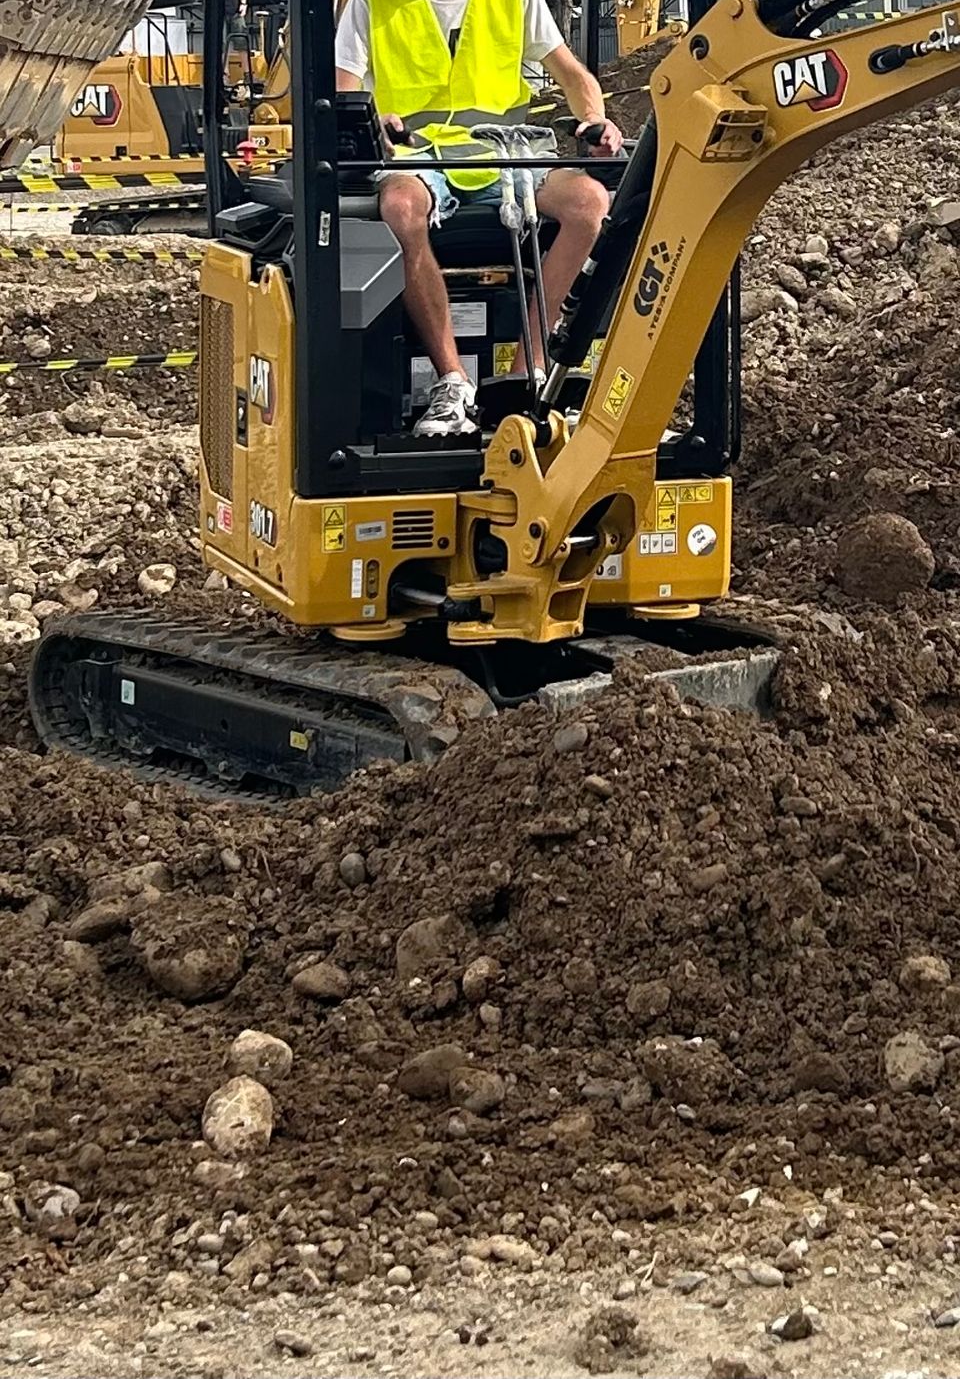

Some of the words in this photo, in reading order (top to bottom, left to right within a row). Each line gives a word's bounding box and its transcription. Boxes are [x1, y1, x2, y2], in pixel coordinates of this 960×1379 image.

[773, 51, 827, 105] CAT
[633, 257, 665, 316] CGT
[663, 236, 686, 292] COMPANY
[250, 356, 270, 408] CAT
